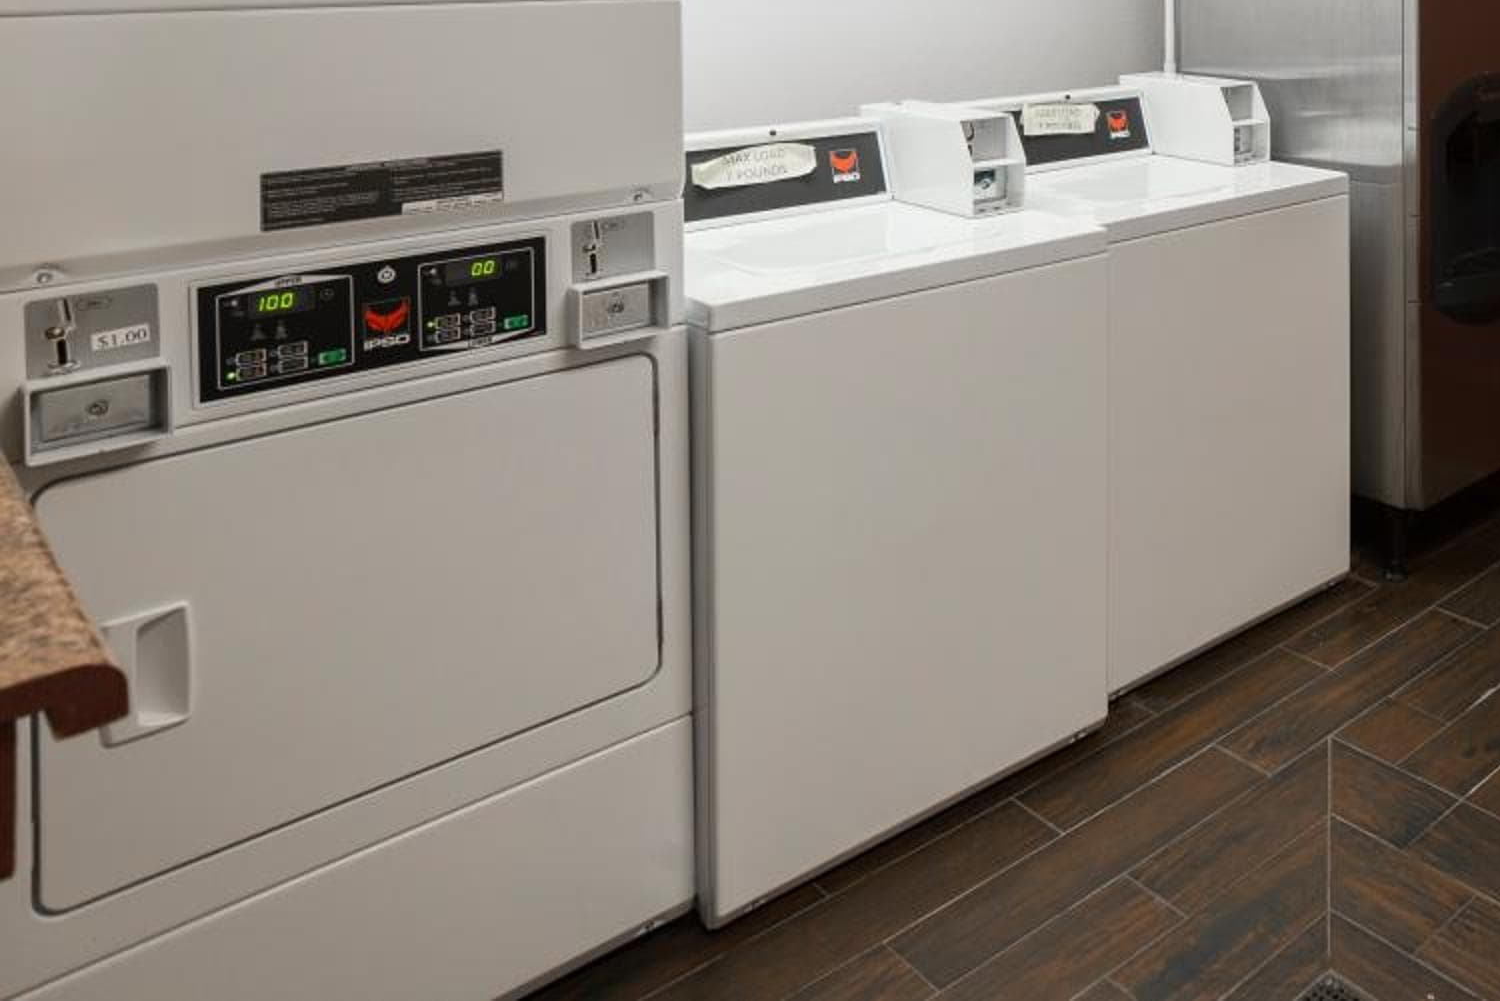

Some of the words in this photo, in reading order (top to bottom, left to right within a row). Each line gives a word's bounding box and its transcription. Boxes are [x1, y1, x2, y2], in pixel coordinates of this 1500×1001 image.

[259, 292, 294, 312] 100
[97, 326, 147, 348] $1.00
[363, 334, 410, 351] IPSO
